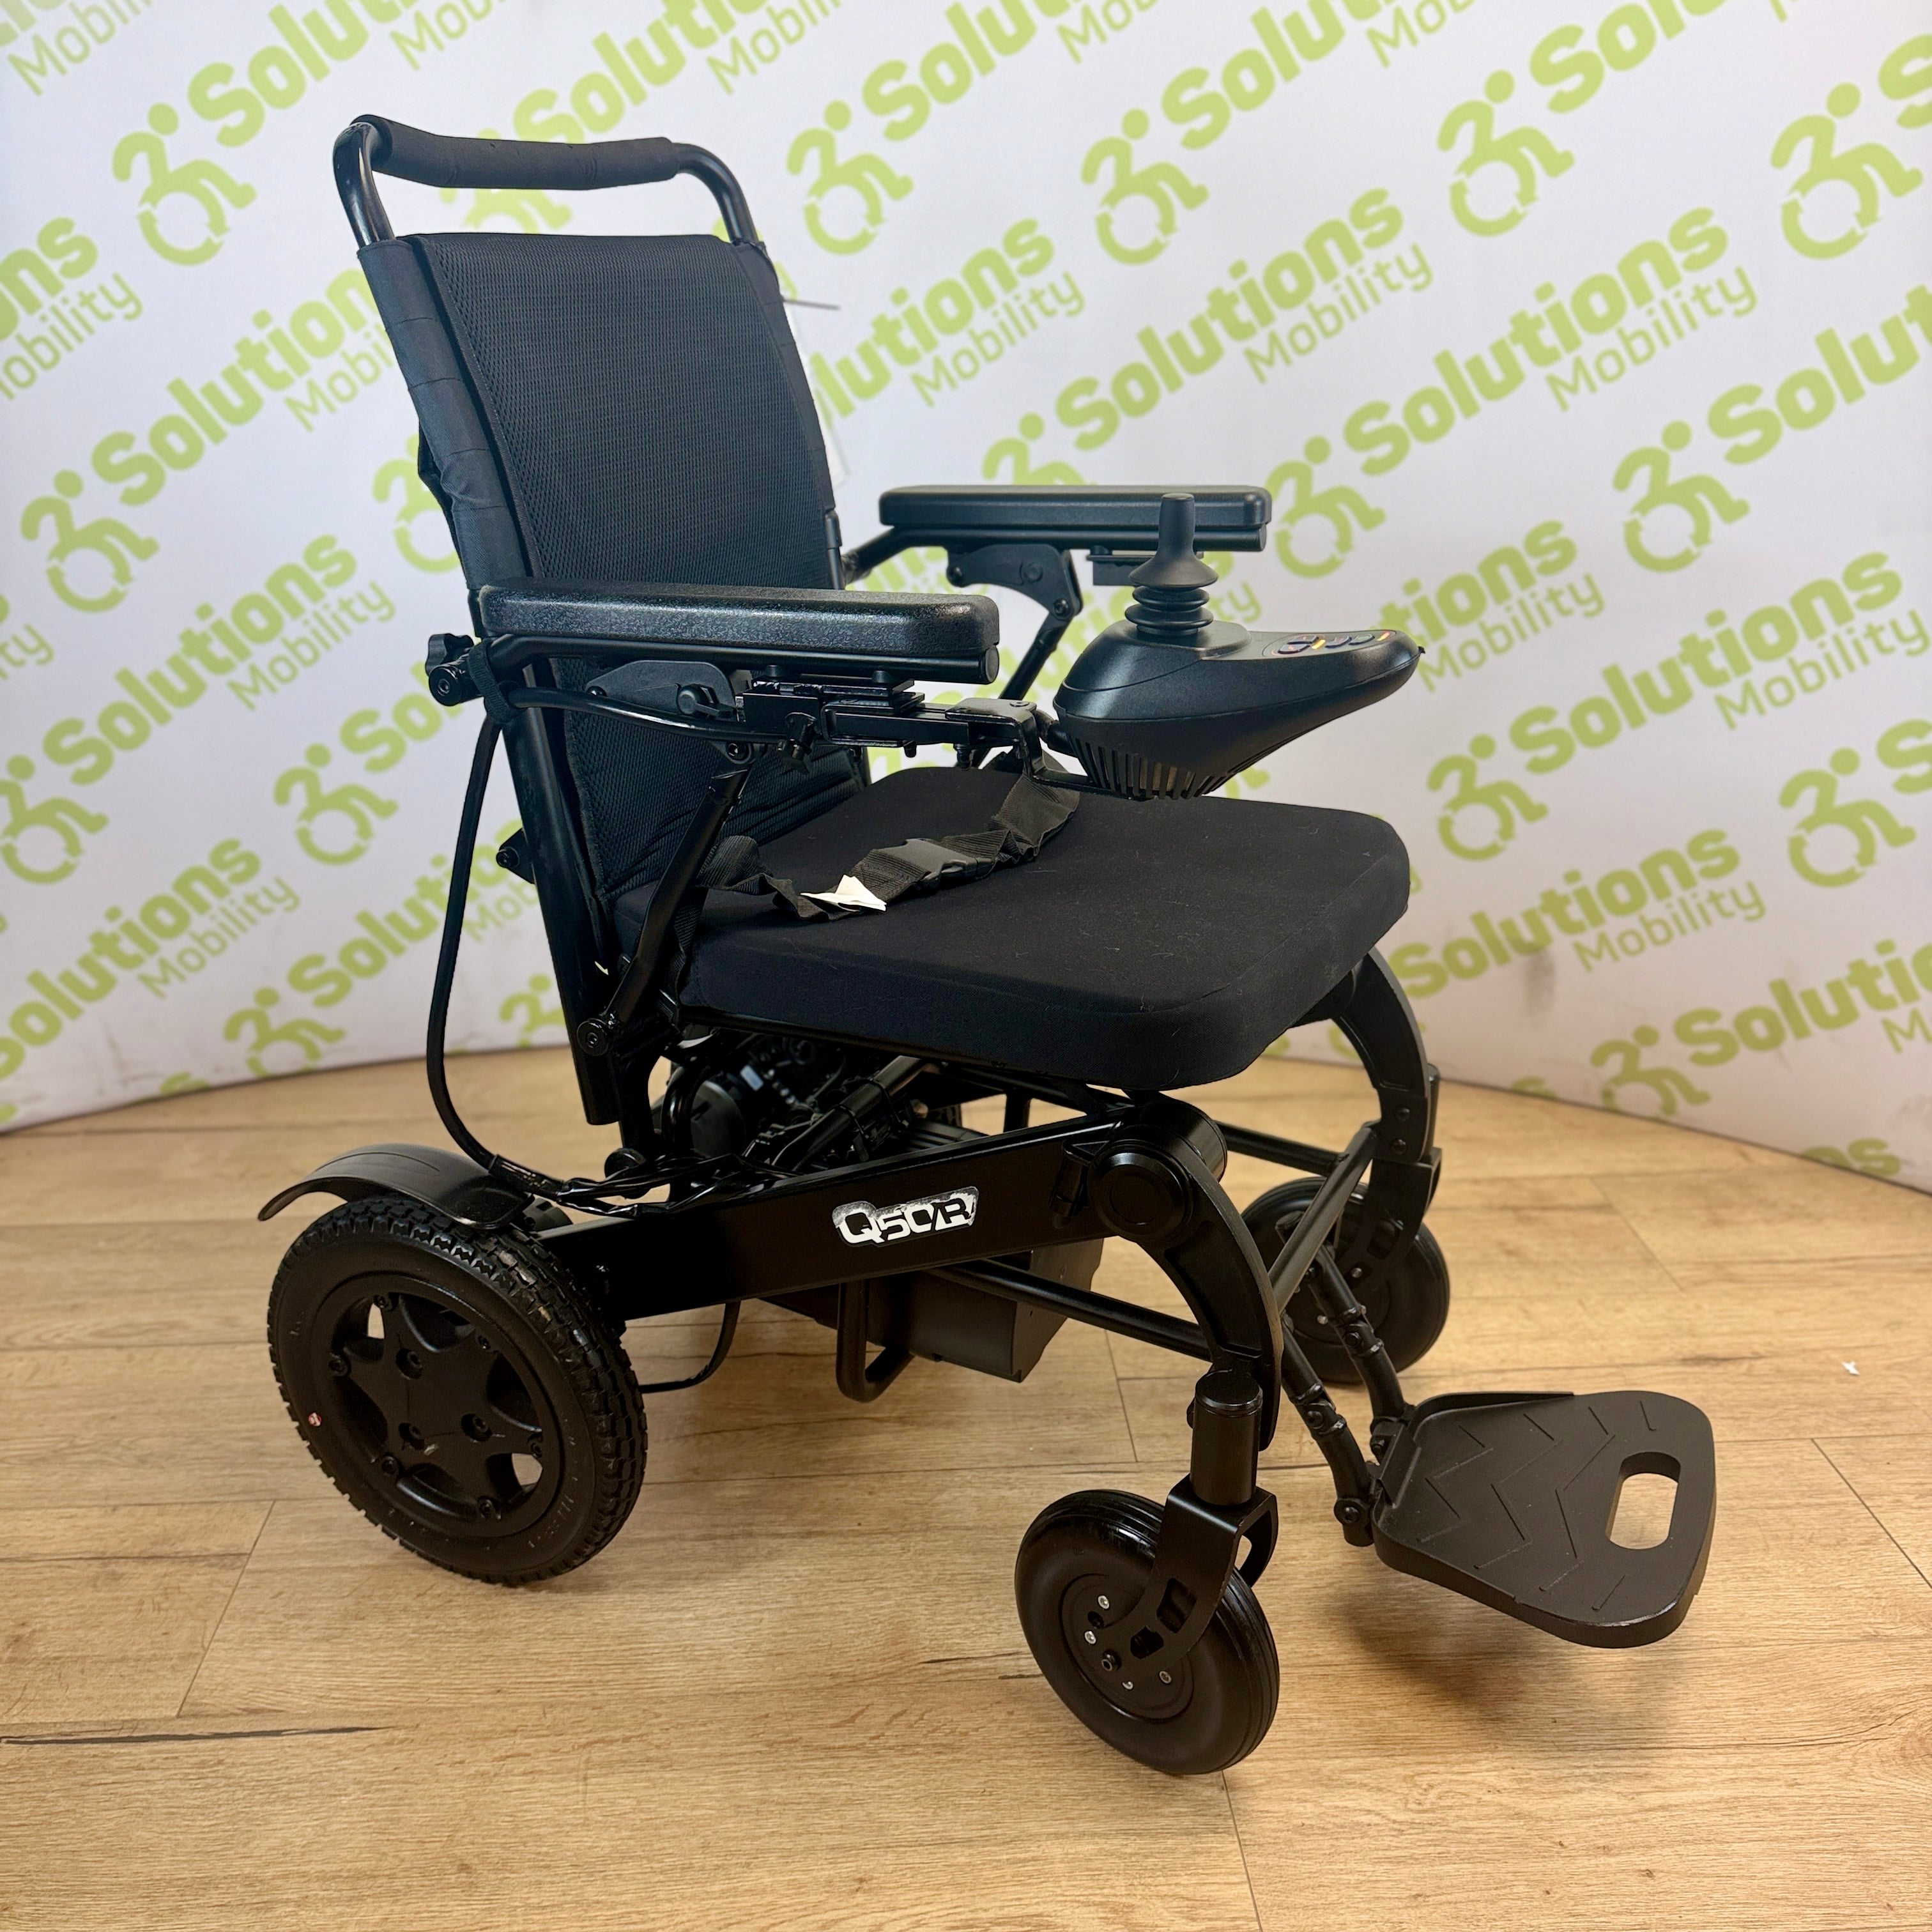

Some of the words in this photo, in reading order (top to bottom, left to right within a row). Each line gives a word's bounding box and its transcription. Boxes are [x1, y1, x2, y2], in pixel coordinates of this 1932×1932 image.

[809, 217, 1056, 429] lutions
[909, 270, 1087, 408] Mobility
[1054, 186, 1406, 452] Solutions
[1243, 242, 1435, 384] Mobility
[1342, 205, 1730, 477] Solutions
[1545, 264, 1759, 413] Mobility
[227, 581, 396, 710] Mobility
[1366, 518, 1579, 647] tions
[1414, 572, 1606, 693] Mobility
[42, 533, 358, 786] Solutions
[1508, 550, 1905, 776] Solutions
[1713, 608, 1932, 731] Mobility
[137, 877, 301, 999] Mobility
[1388, 828, 1742, 999] Solutions
[1572, 880, 1767, 973] Mobility
